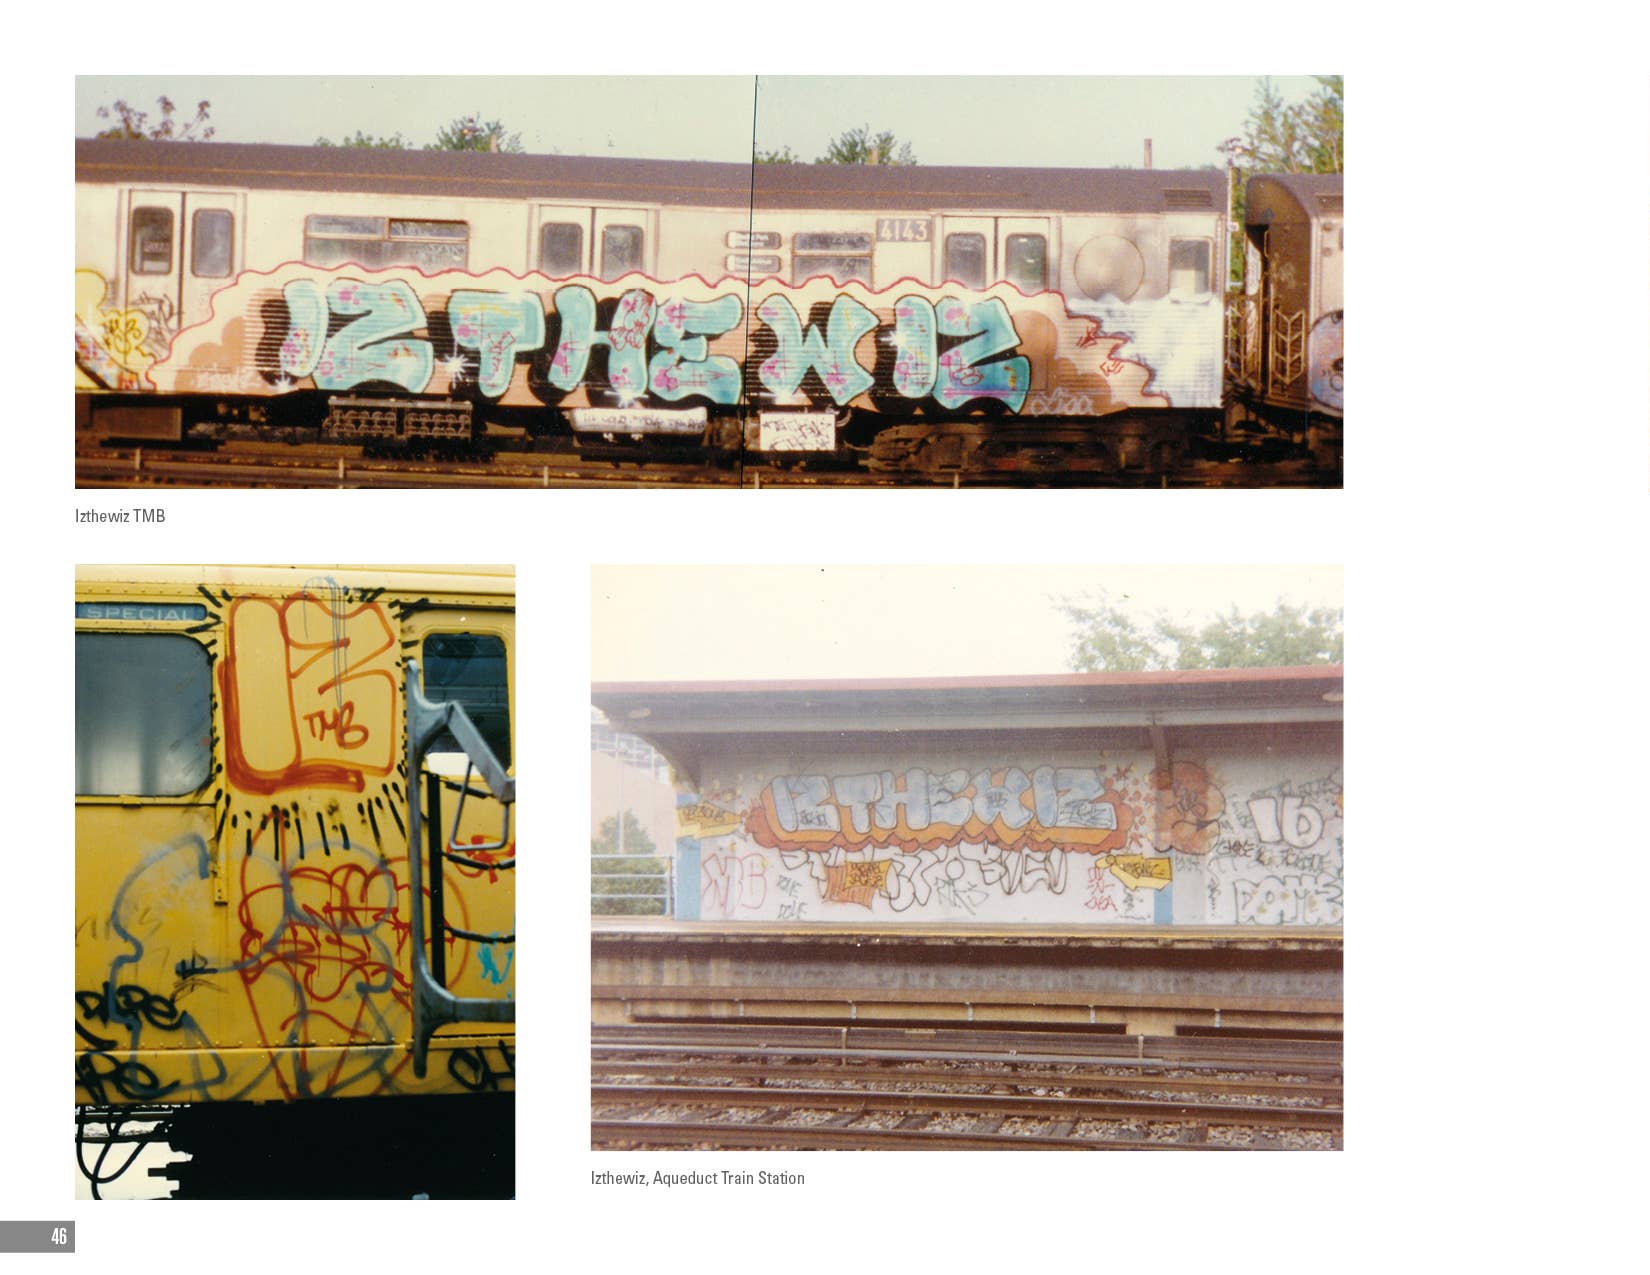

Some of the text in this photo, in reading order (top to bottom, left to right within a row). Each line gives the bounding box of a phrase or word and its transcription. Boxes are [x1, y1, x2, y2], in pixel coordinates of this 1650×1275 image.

[879, 219, 928, 241] 4143
[86, 605, 191, 621] SPECIAL
[303, 700, 369, 750] TMB
